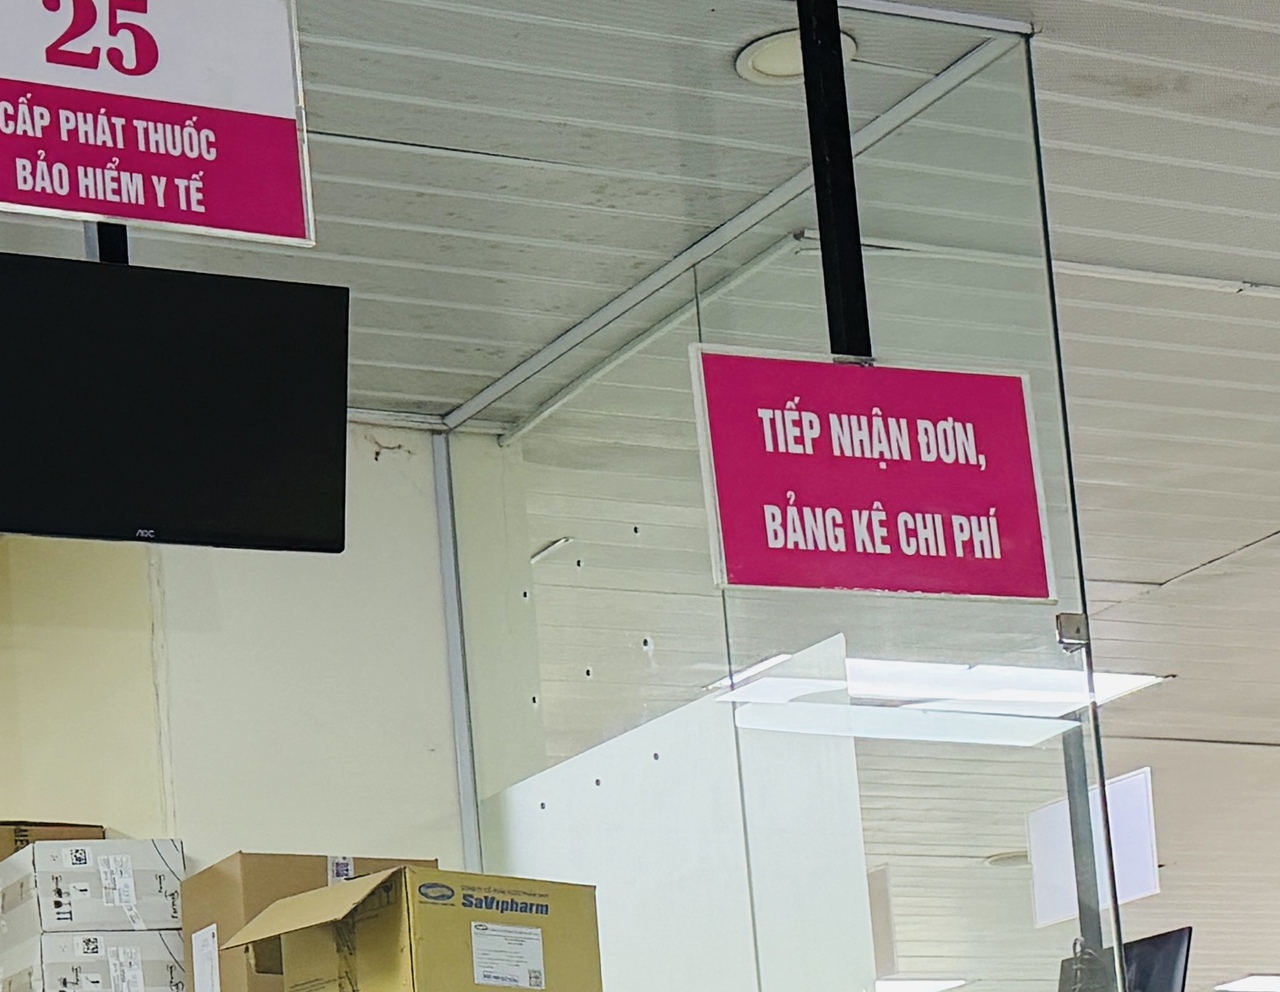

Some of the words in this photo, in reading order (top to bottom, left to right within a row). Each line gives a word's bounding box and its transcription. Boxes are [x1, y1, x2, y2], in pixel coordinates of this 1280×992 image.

[41, 0, 160, 77] 25
[59, 107, 126, 149] PHÁT
[133, 115, 218, 161] THUỐC
[15, 149, 70, 196] BẢO
[77, 157, 144, 206] HIỂM
[151, 176, 169, 208] Y
[174, 170, 207, 213] TẾ
[756, 396, 821, 455] TIẾP
[828, 406, 912, 470] NHẬN
[916, 416, 986, 471] ĐƠN,
[763, 490, 846, 553] BẢNG
[851, 501, 891, 555] KÊ
[897, 511, 946, 557] CHI
[951, 507, 1002, 560] PHÍ
